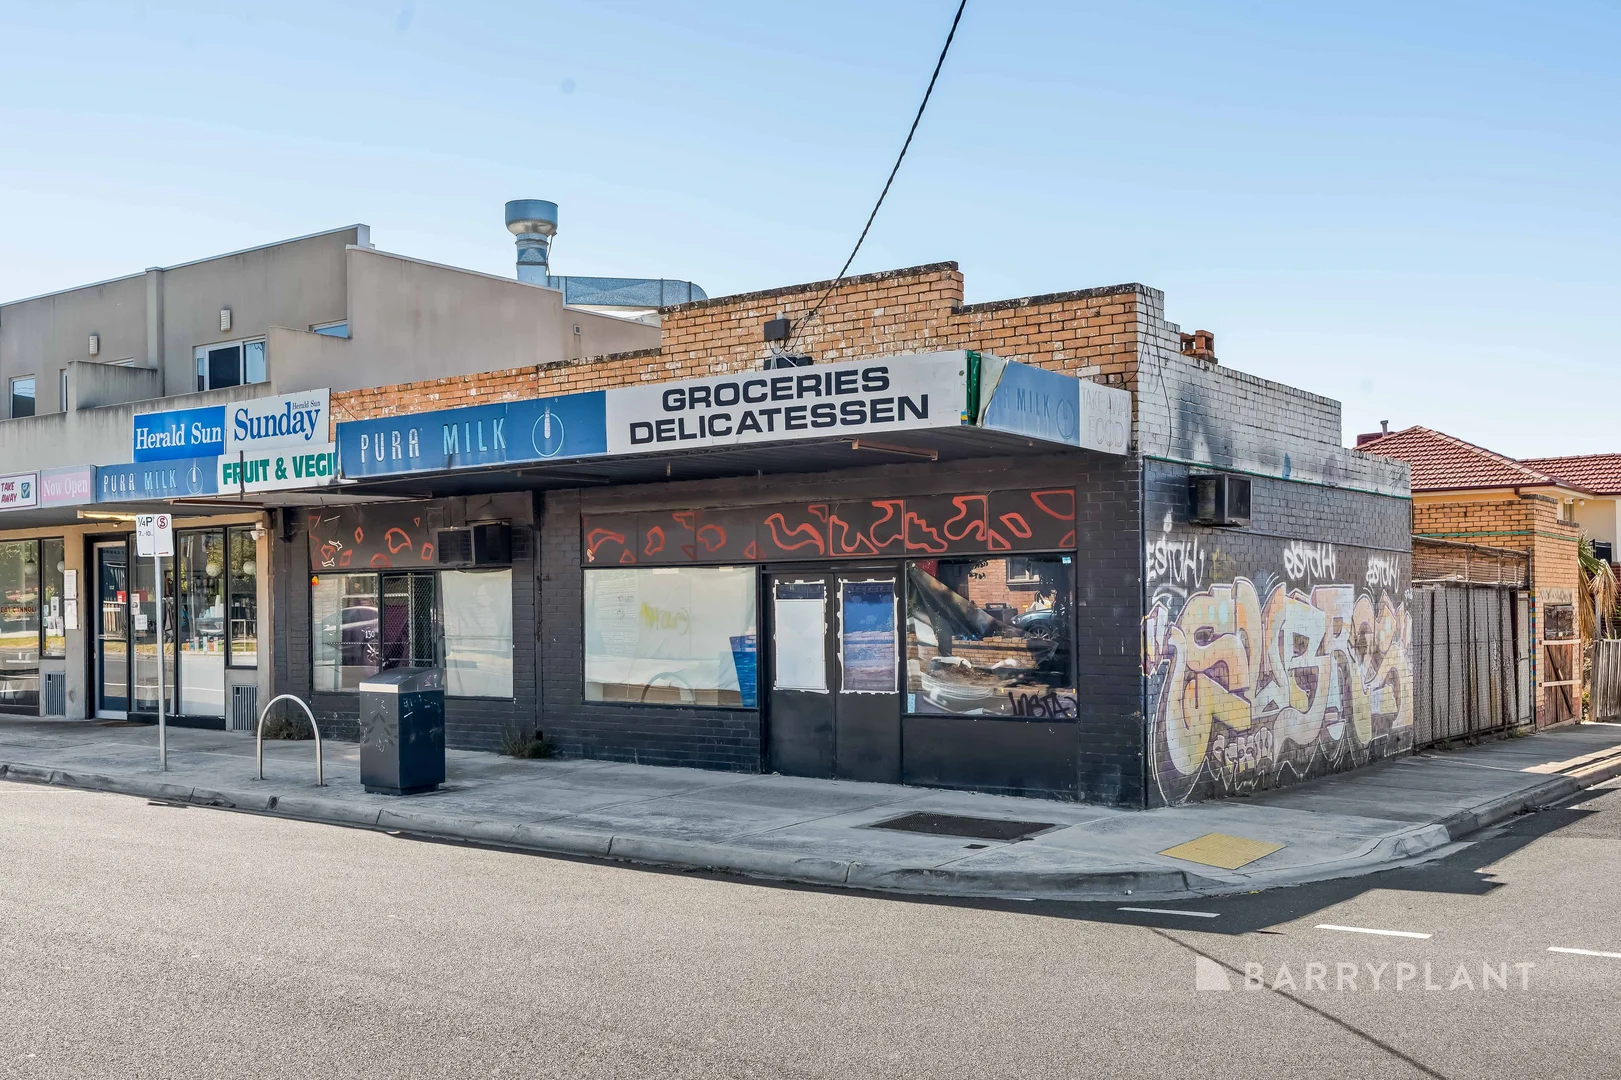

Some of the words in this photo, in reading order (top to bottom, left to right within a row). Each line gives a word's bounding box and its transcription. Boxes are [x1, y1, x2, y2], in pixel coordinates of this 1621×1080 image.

[662, 366, 890, 411] GROCERIES
[1016, 387, 1050, 418] MILK
[292, 401, 309, 410] Herald
[630, 394, 930, 445] DELICATESSEN
[234, 401, 321, 441] Sunday
[136, 424, 185, 450] Herald
[191, 422, 222, 446] Sun
[361, 428, 419, 464] PURA
[443, 417, 506, 456] MILK
[103, 474, 135, 493] PURA
[144, 469, 178, 491] MILK
[222, 458, 270, 485] FRUIT
[275, 457, 288, 481] &
[1, 481, 15, 492] TAKE
[1, 493, 17, 503] AWAY
[43, 480, 62, 497] Now
[64, 477, 88, 498] Open
